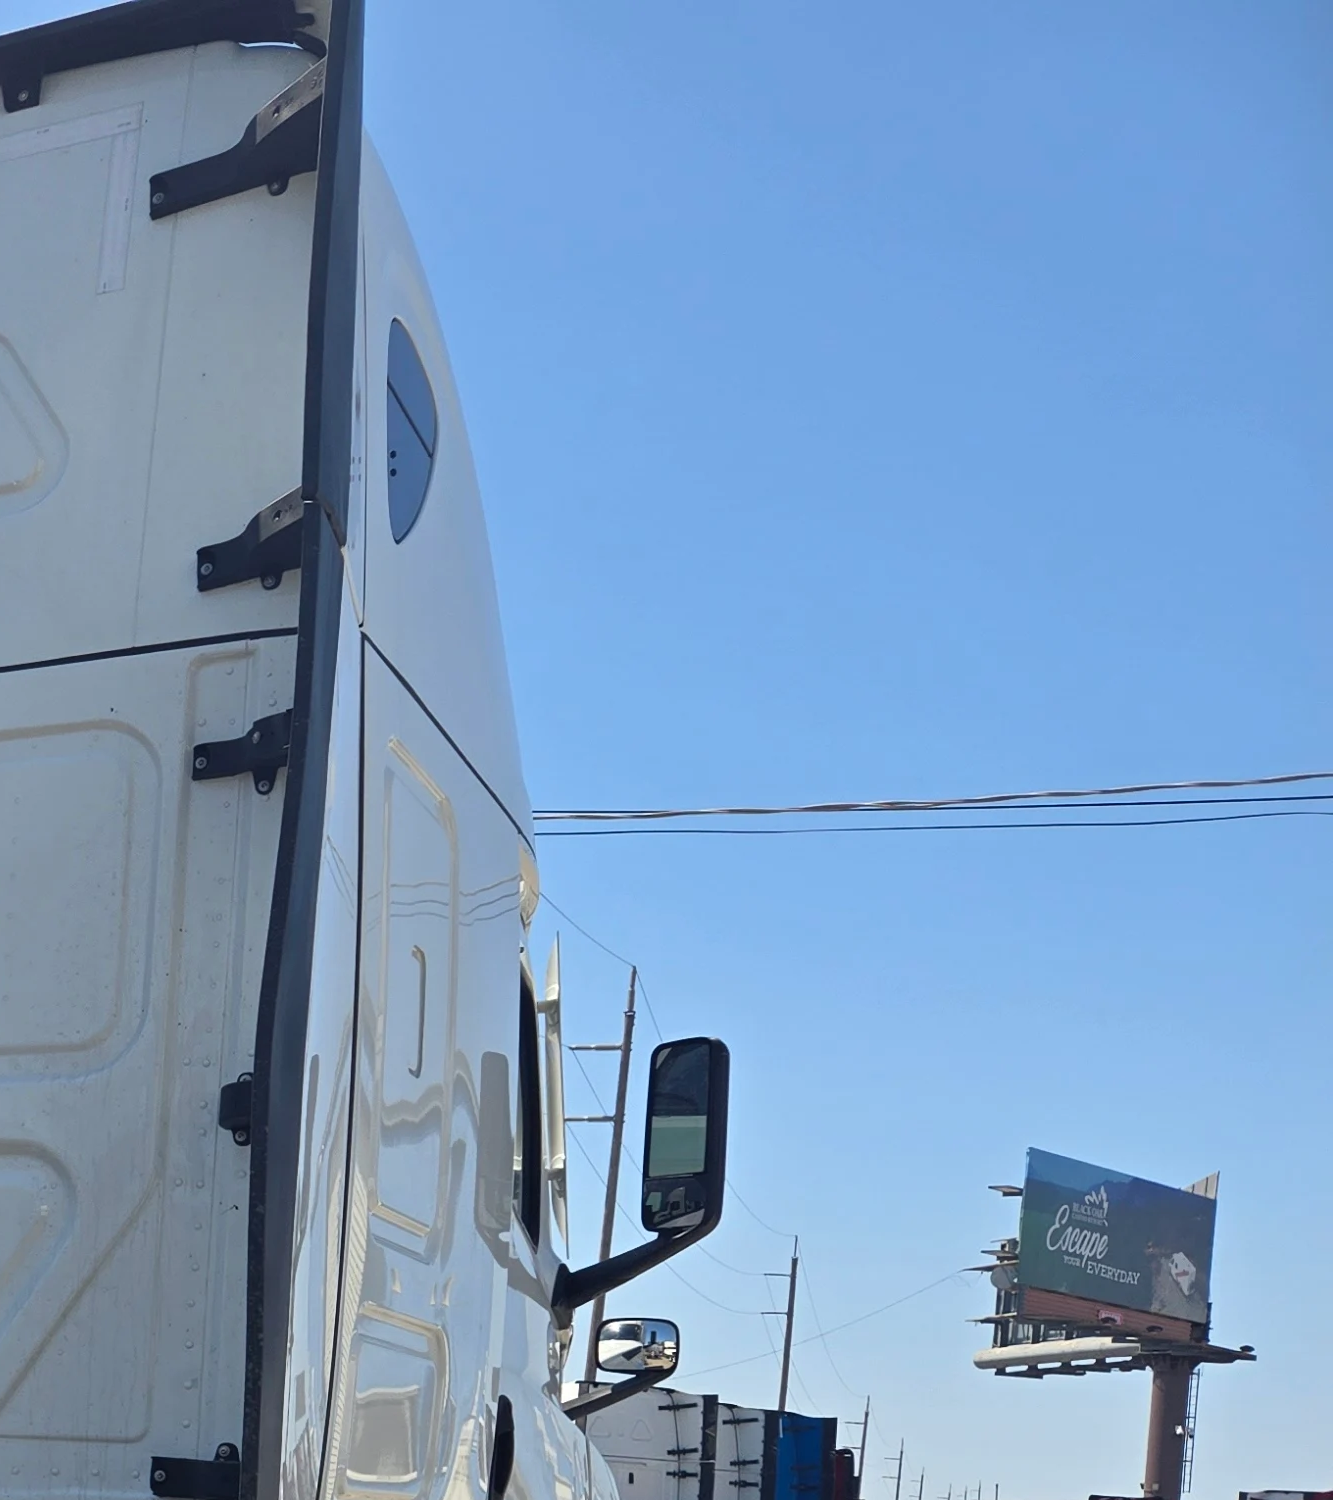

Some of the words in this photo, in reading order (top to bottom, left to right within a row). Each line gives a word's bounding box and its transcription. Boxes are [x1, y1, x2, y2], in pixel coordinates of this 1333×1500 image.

[1073, 1202, 1090, 1215] BLACK
[1047, 1204, 1108, 1268] Escape
[1063, 1255, 1081, 1266] YOUR
[1086, 1260, 1140, 1285] EVERYDAY
